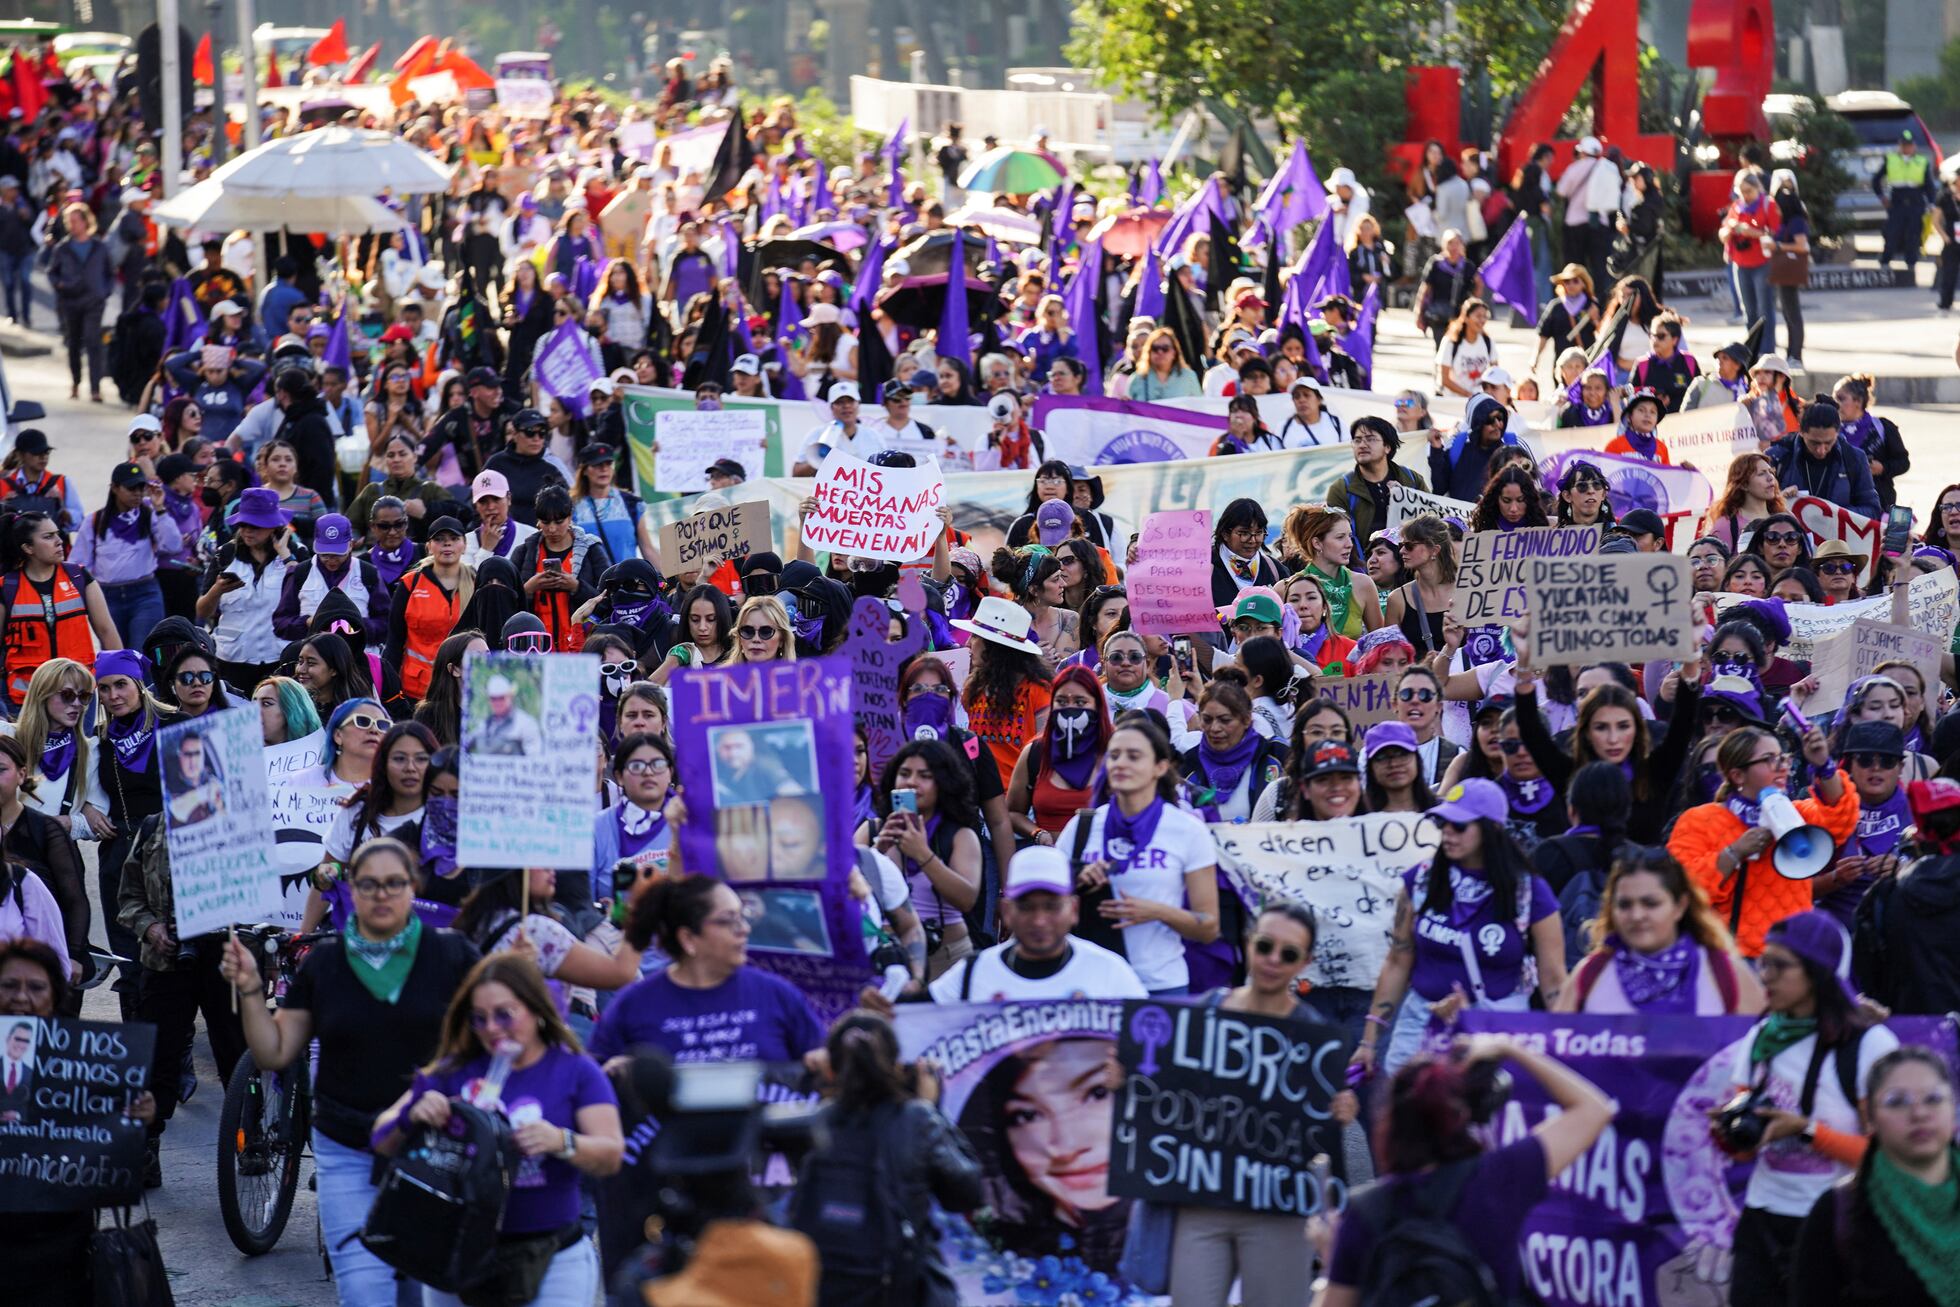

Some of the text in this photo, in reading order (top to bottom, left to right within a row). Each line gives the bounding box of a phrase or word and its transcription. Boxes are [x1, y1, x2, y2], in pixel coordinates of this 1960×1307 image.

[1806, 270, 1897, 292] UEREMOS!
[1716, 427, 1759, 443] LIBERTA
[833, 466, 883, 495] MIS
[814, 482, 943, 514] HERMANAS
[708, 507, 742, 531] QUE
[808, 502, 907, 530] MUERTAS
[804, 524, 868, 550] VIVEN
[870, 533, 900, 552] EN
[1462, 528, 1598, 564] EL FEMINICIDIO
[1150, 565, 1184, 577] PARA
[1456, 565, 1484, 589] ES
[1490, 561, 1513, 584] UN
[1533, 561, 1617, 584] DESDE
[1135, 583, 1206, 597] DESTRUIR
[1466, 589, 1499, 620] DE
[1539, 608, 1649, 627] HASTA CDMX
[862, 648, 884, 669] NO
[864, 691, 888, 710] NOS
[1259, 831, 1336, 855] dicen
[37, 1017, 128, 1060] No nos
[1552, 1027, 1647, 1058] Todas
[35, 1055, 146, 1088] vamos a
[0, 1152, 97, 1188] minicida
[1144, 1133, 1223, 1194] SIN
[1524, 1231, 1643, 1307] CTORA
